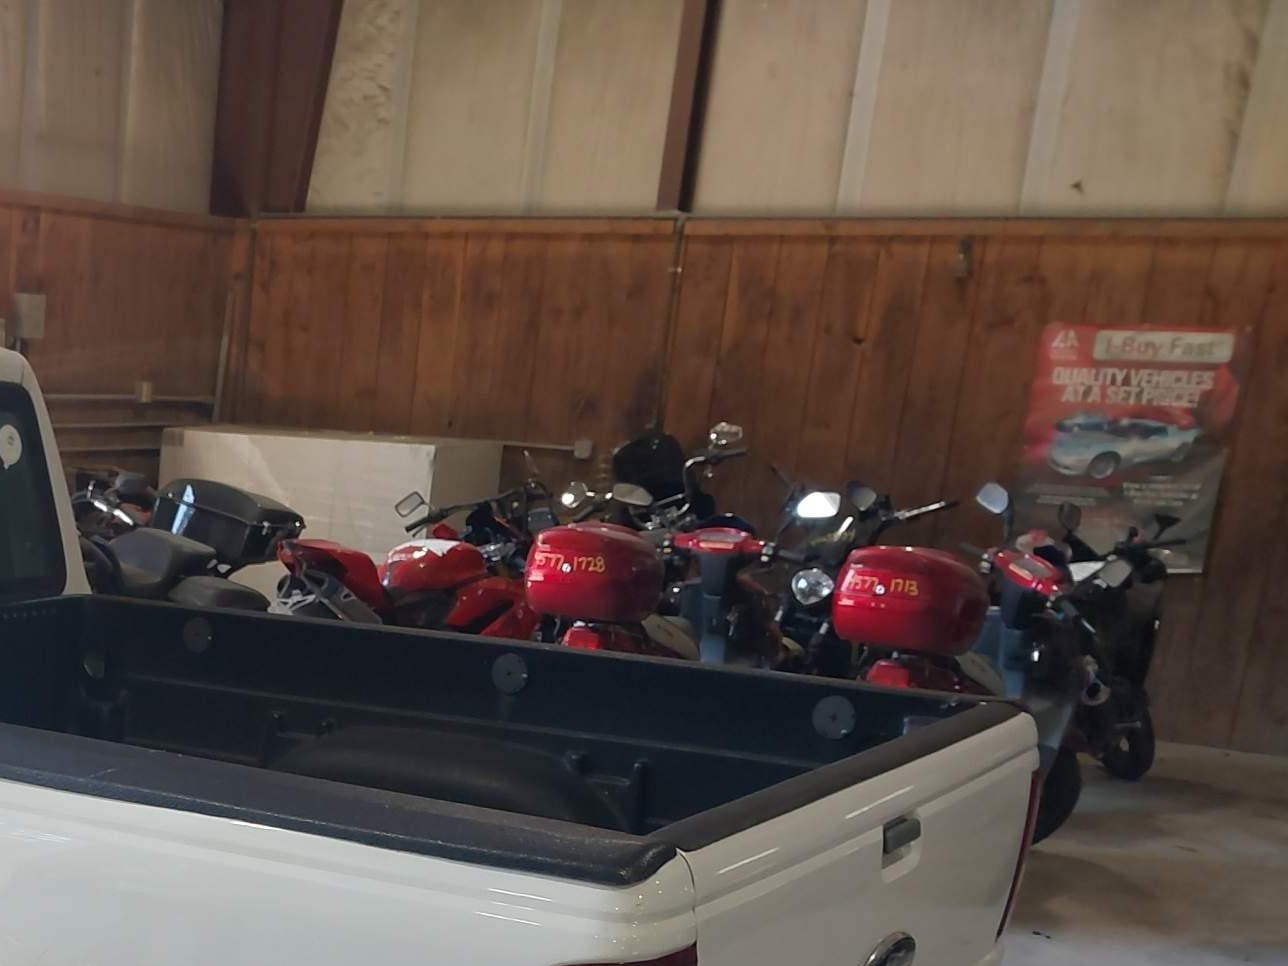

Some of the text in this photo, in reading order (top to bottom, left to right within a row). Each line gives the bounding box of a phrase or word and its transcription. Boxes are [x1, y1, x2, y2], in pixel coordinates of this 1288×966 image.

[1051, 366, 1215, 390] QUALITY VEHICLES
[1106, 386, 1141, 405] SET
